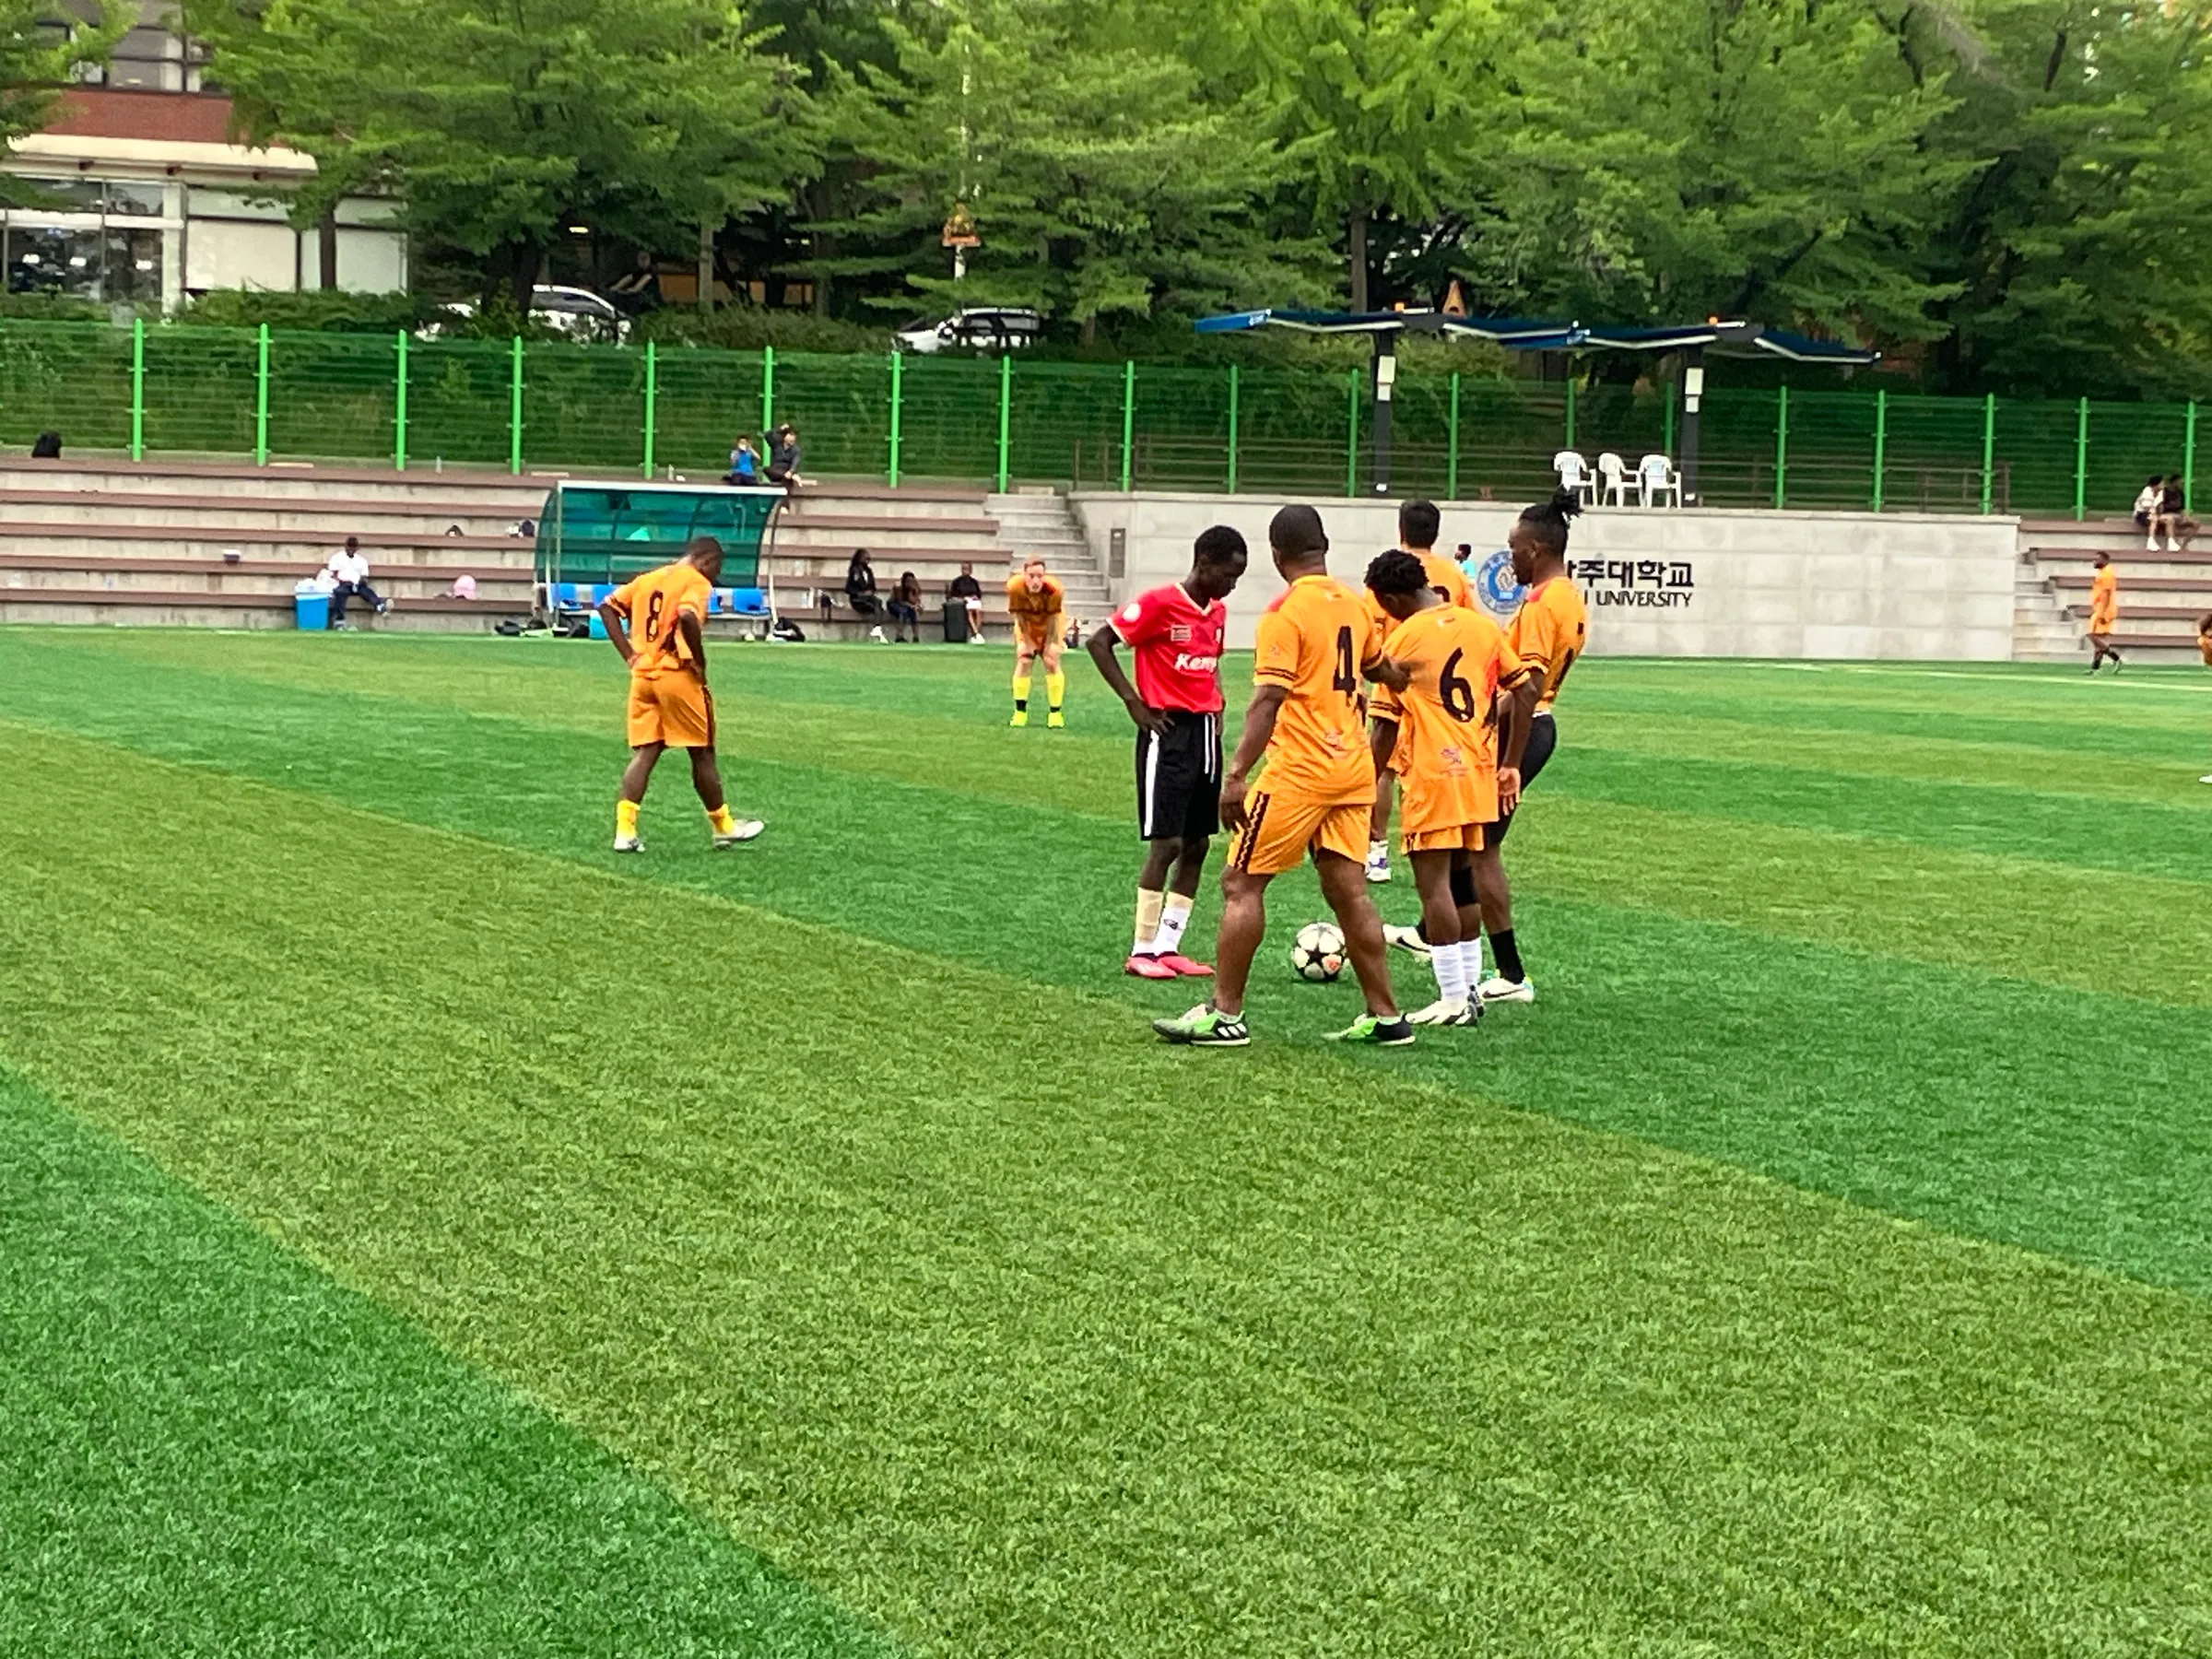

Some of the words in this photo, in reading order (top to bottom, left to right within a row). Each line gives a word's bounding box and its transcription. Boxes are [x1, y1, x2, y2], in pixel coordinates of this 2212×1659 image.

[646, 590, 664, 643] 8
[1595, 590, 1693, 607] UNIVERSITY
[1333, 625, 1357, 699] 4
[1440, 646, 1475, 723] 6
